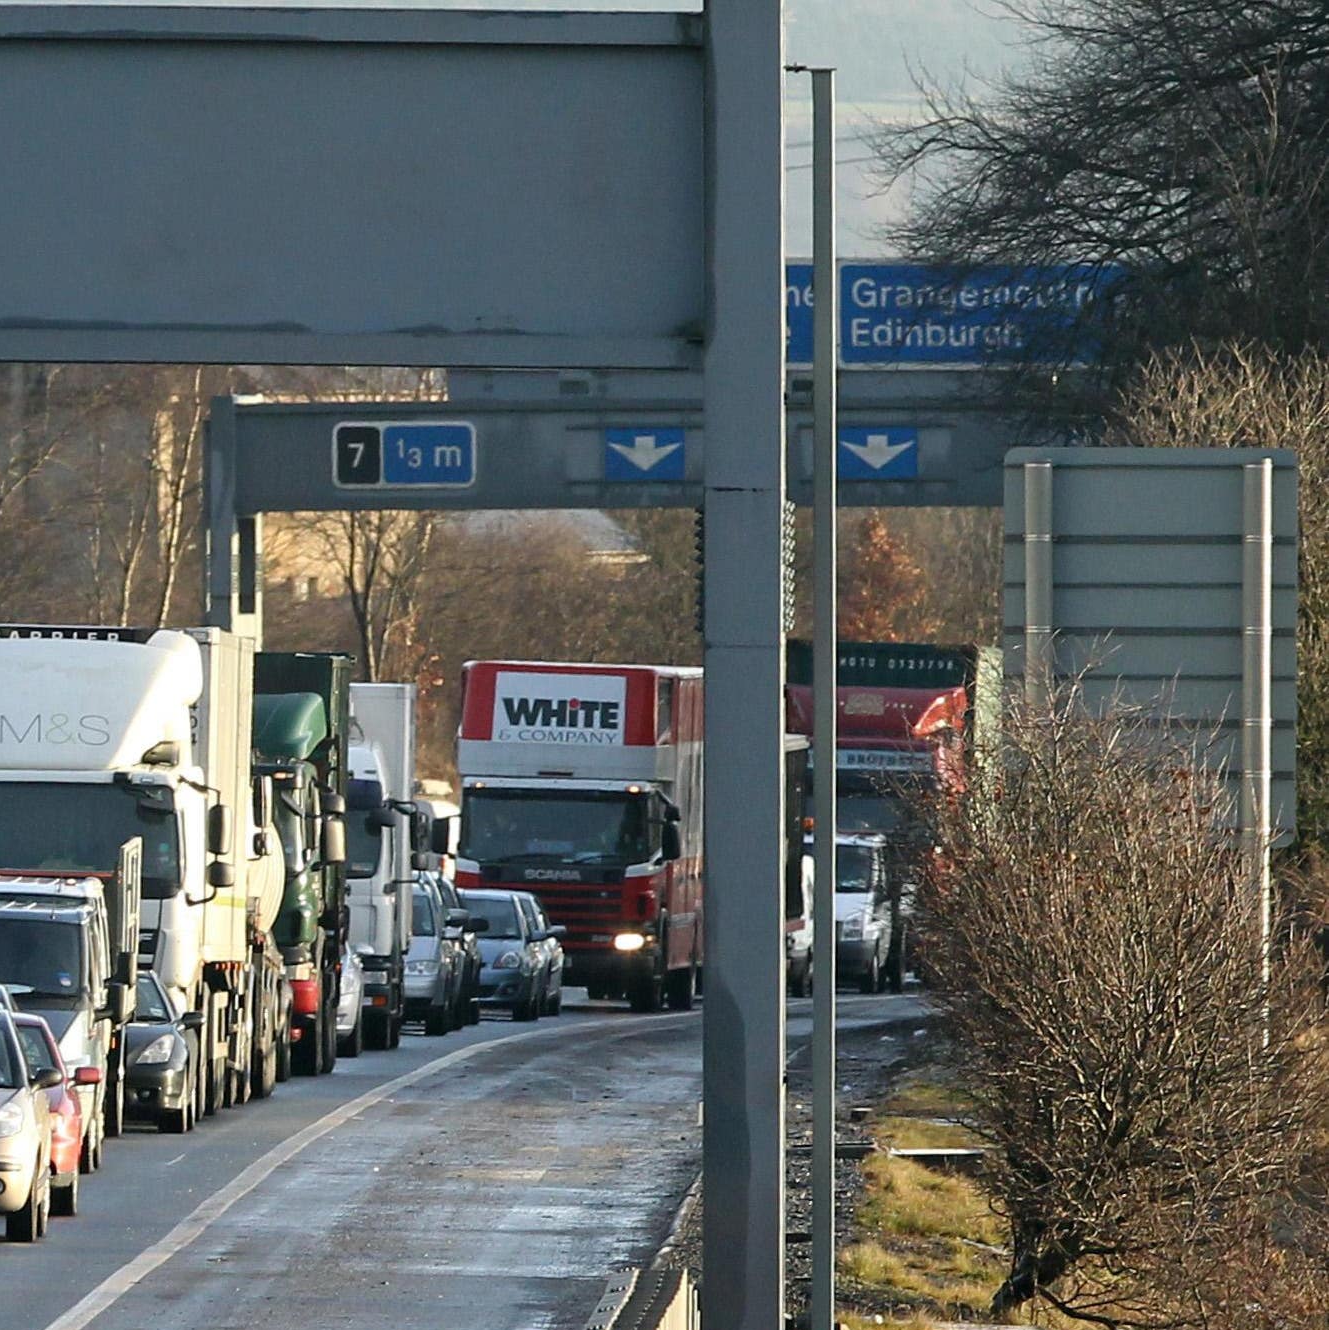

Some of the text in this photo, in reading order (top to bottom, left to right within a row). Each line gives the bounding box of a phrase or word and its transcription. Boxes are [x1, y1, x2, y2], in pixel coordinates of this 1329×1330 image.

[850, 318, 1023, 353] Edinburgh
[347, 442, 364, 468] 7
[433, 445, 462, 467] m
[0, 713, 110, 746] M&S
[518, 729, 618, 744] COMPANY
